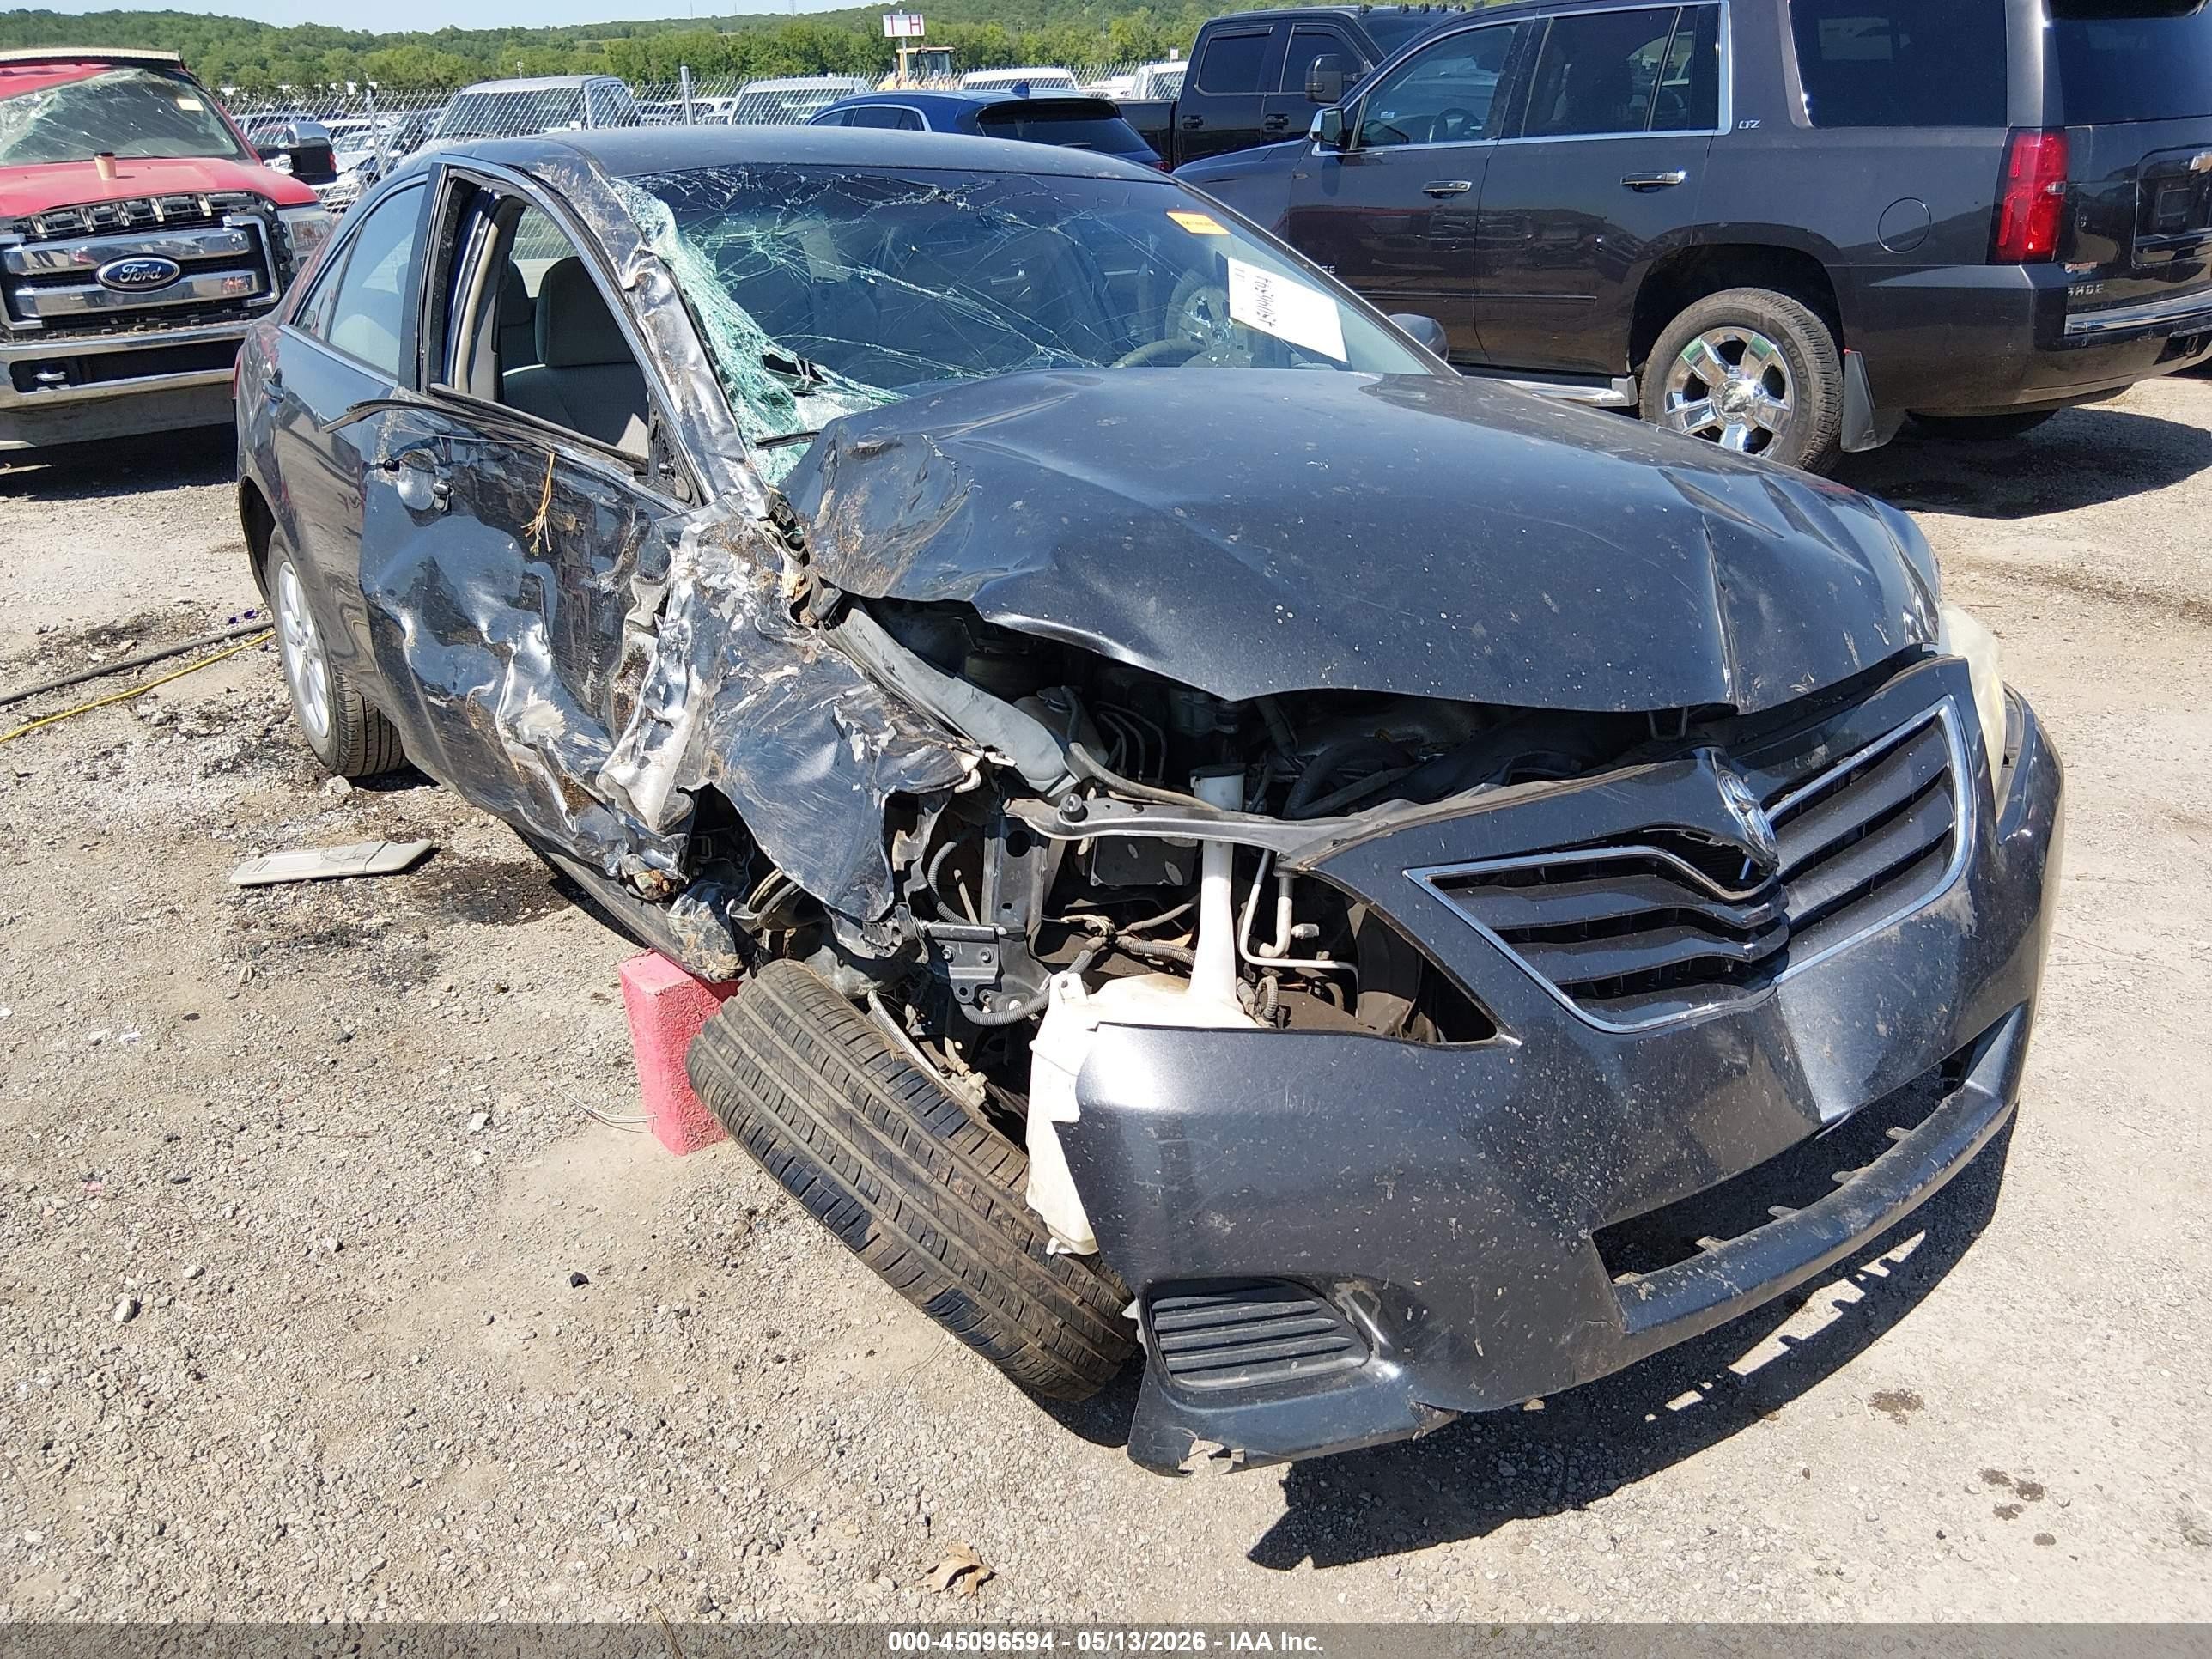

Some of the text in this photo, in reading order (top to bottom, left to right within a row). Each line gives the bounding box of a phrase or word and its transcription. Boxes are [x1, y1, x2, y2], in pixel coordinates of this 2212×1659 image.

[908, 15, 921, 35] H
[1737, 119, 1762, 130] LTZ
[118, 263, 162, 283] Ford
[2067, 283, 2105, 297] AHOE
